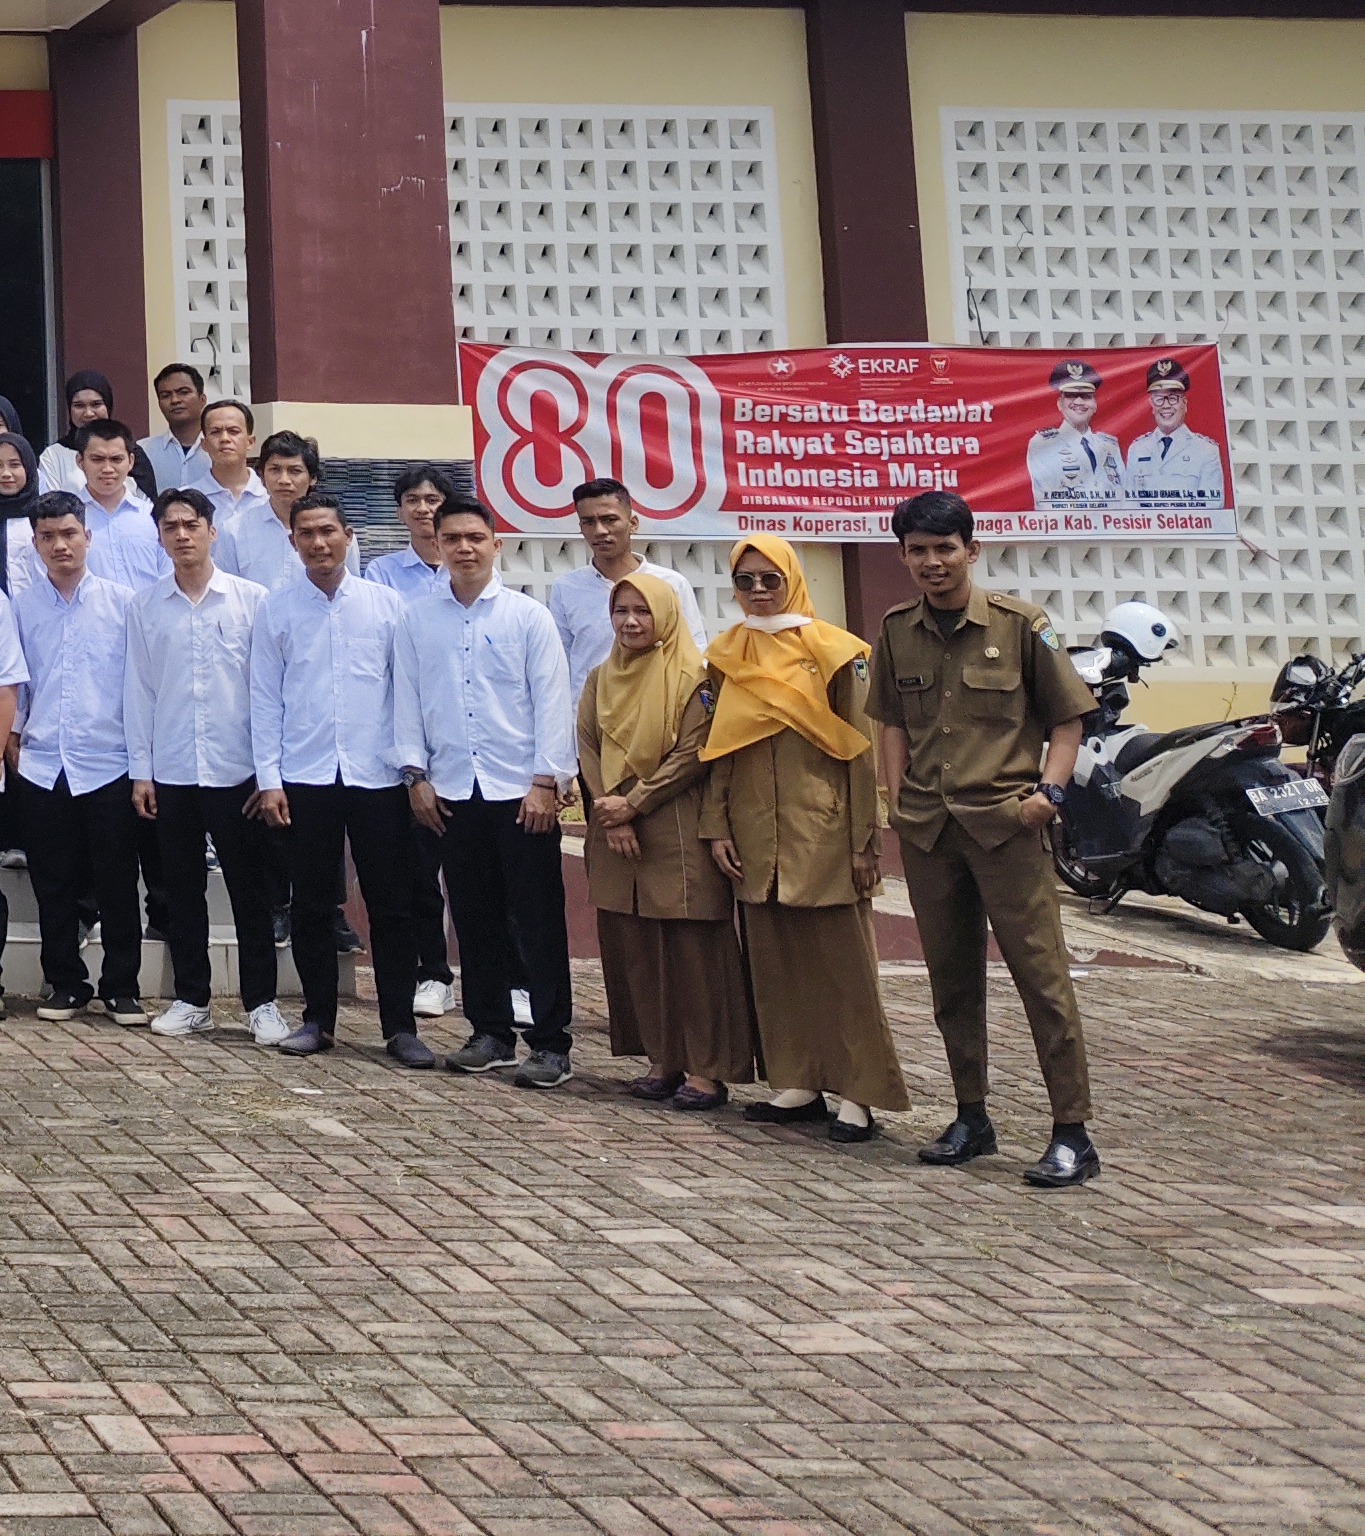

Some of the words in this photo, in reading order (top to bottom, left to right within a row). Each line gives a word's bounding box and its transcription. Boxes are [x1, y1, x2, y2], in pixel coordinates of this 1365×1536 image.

[858, 358, 919, 374] EKRAF
[734, 398, 848, 423] Bersatu
[858, 399, 994, 423] Berdaulat
[476, 346, 726, 533] 80
[734, 430, 836, 460] Rakyat
[845, 430, 980, 460] Sejahtera
[737, 462, 879, 488] Indonesia
[888, 462, 959, 491] Maju
[742, 496, 809, 506] DIRGAHAYU
[813, 496, 870, 506] REPUBLIK
[738, 516, 786, 530] Dinas
[793, 516, 872, 534] Koperasi,
[1019, 515, 1058, 533] Kerja
[1065, 515, 1097, 530] Kab.
[1104, 515, 1152, 530] Pesisir
[1158, 514, 1212, 529] Selatan
[1249, 790, 1268, 802] BA
[1304, 780, 1322, 792] OK
